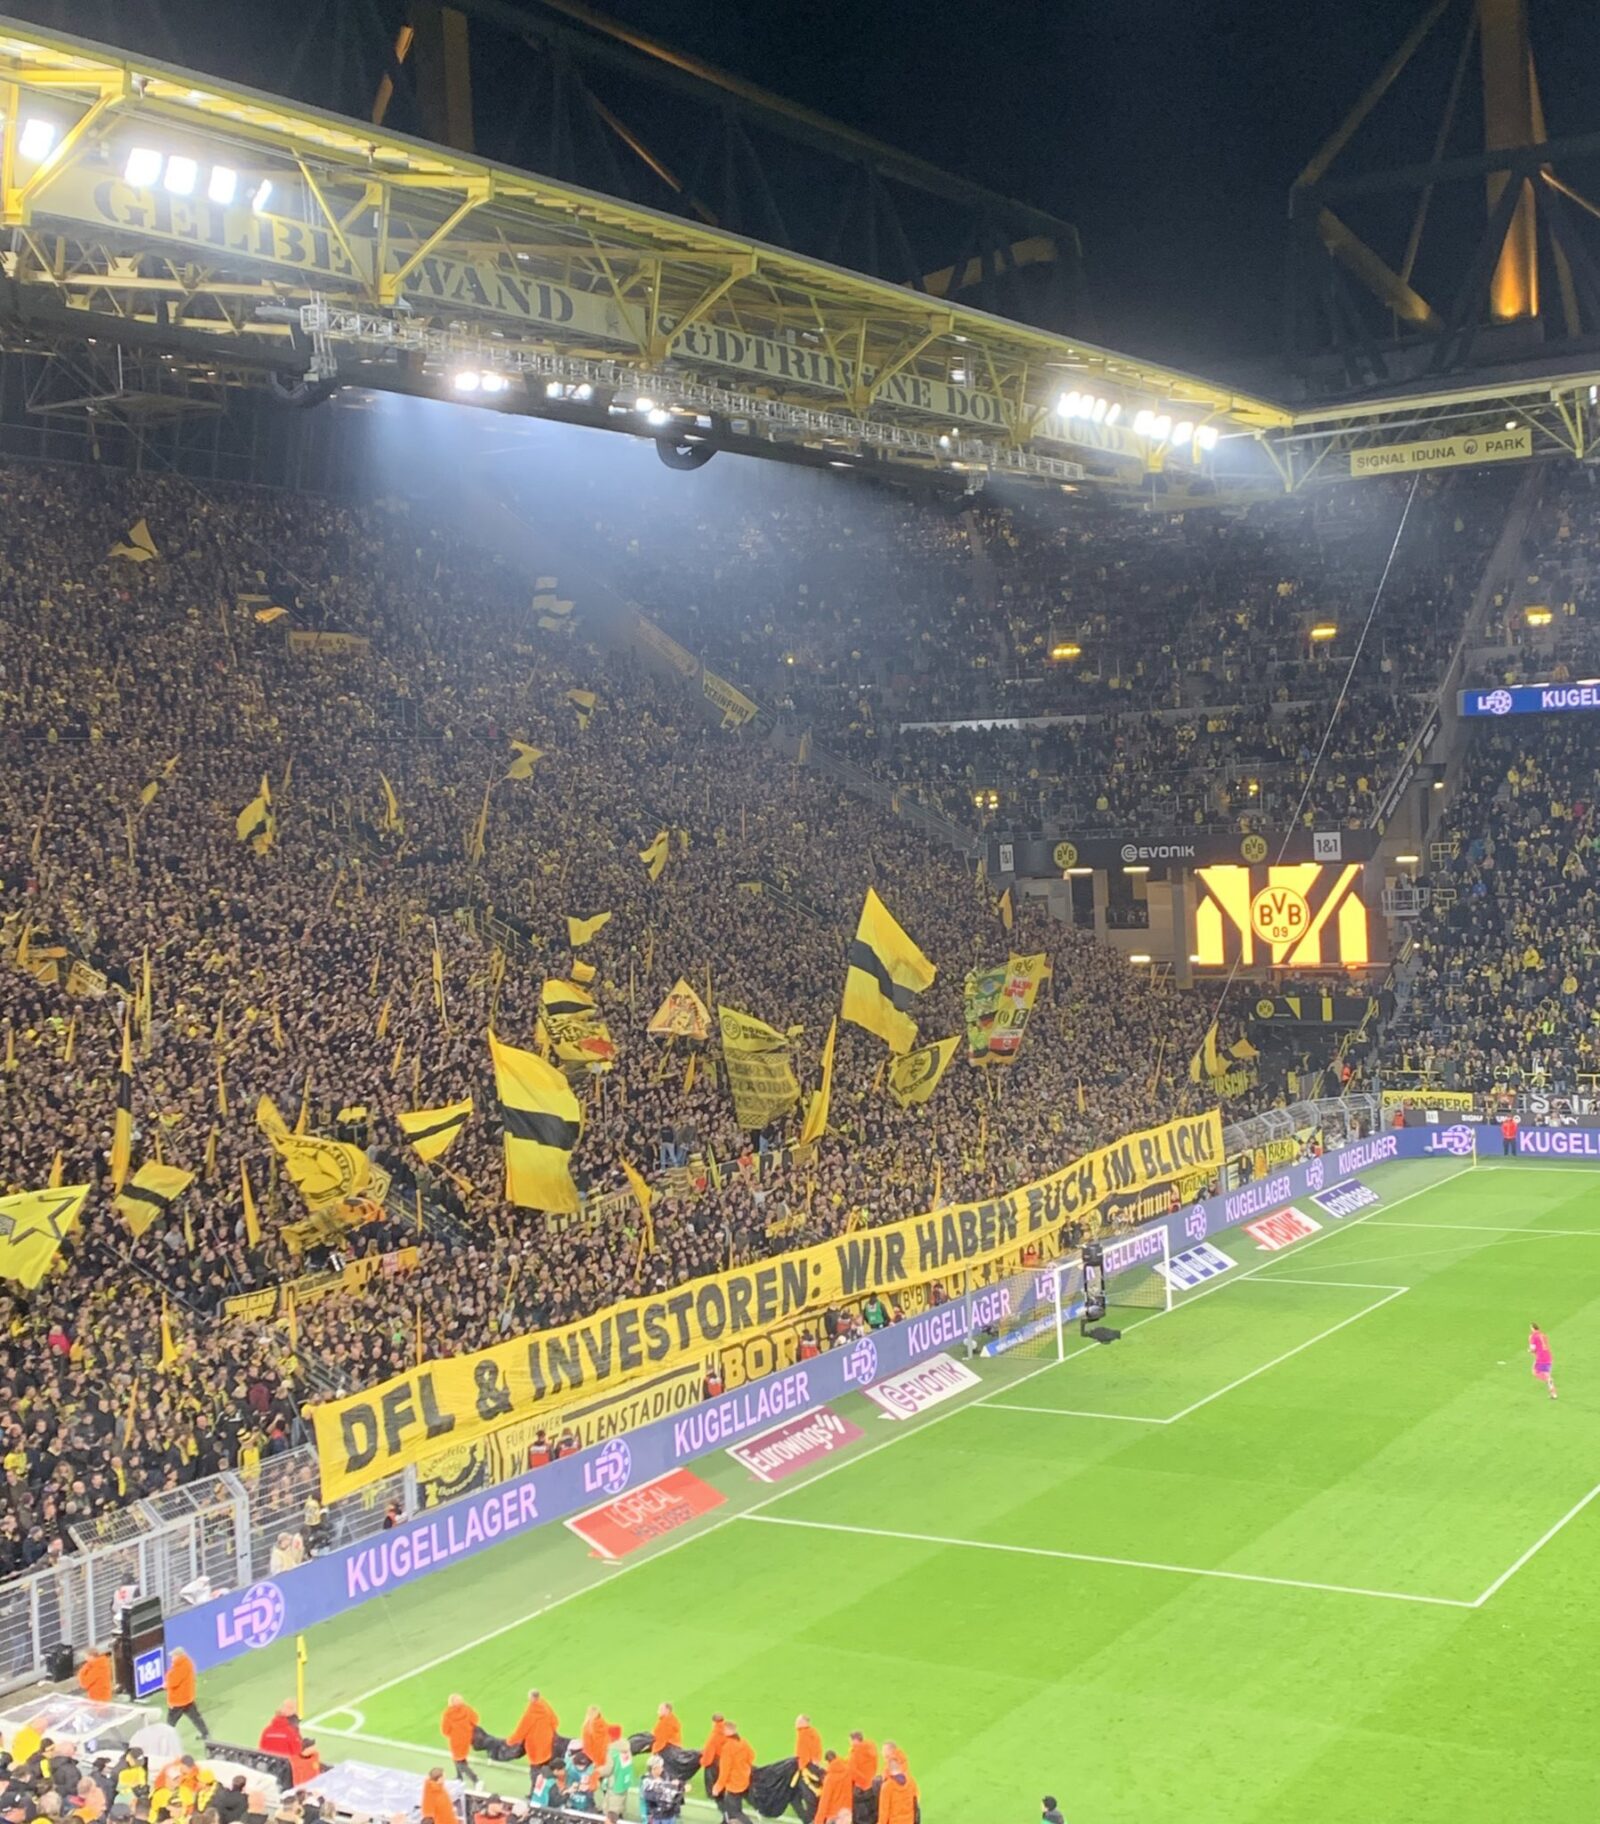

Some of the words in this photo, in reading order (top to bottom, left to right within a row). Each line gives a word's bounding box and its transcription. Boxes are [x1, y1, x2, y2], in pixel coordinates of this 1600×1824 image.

[94, 178, 353, 276] GELBE
[393, 249, 574, 323] WAND
[946, 386, 1126, 450] DORMUND
[1356, 453, 1406, 468] SIGNAL
[1412, 446, 1456, 462] IDUNA
[1485, 437, 1526, 453] PARK
[1477, 692, 1509, 712] LFD
[1135, 845, 1196, 860] EVONIK
[1245, 839, 1265, 855] BVB
[1316, 839, 1338, 853] 1&1
[1259, 893, 1302, 926] BVB
[1272, 927, 1288, 937] 09
[1338, 1135, 1398, 1175] KUGELLAGER
[1432, 1129, 1471, 1152] LFD
[1520, 1131, 1600, 1154] KUGEL
[1184, 1207, 1205, 1238] LFD
[1225, 1176, 1292, 1223] KUGELLAGER
[1256, 1212, 1312, 1250] ROWE
[340, 1372, 455, 1473] DFL
[474, 1359, 514, 1421] &
[527, 1258, 823, 1401] INVESTOREN:
[836, 1232, 908, 1297] WIR
[915, 1198, 1019, 1272] HABEN
[1026, 1160, 1097, 1232] EUCH
[1102, 1144, 1137, 1192] IM
[1138, 1119, 1215, 1180] BLICK!
[843, 1343, 875, 1383] LFD
[907, 1288, 1012, 1357] KUGELLAGER
[891, 1362, 967, 1405] EVONIK
[527, 1415, 562, 1440] IMMER
[584, 1445, 628, 1493] LFD
[674, 1370, 810, 1457] KUGELLAGER
[739, 1422, 836, 1473] Eurowings
[216, 1590, 280, 1648] LFD
[347, 1482, 539, 1598] KUGELLAGER
[137, 1657, 161, 1685] 1&1
